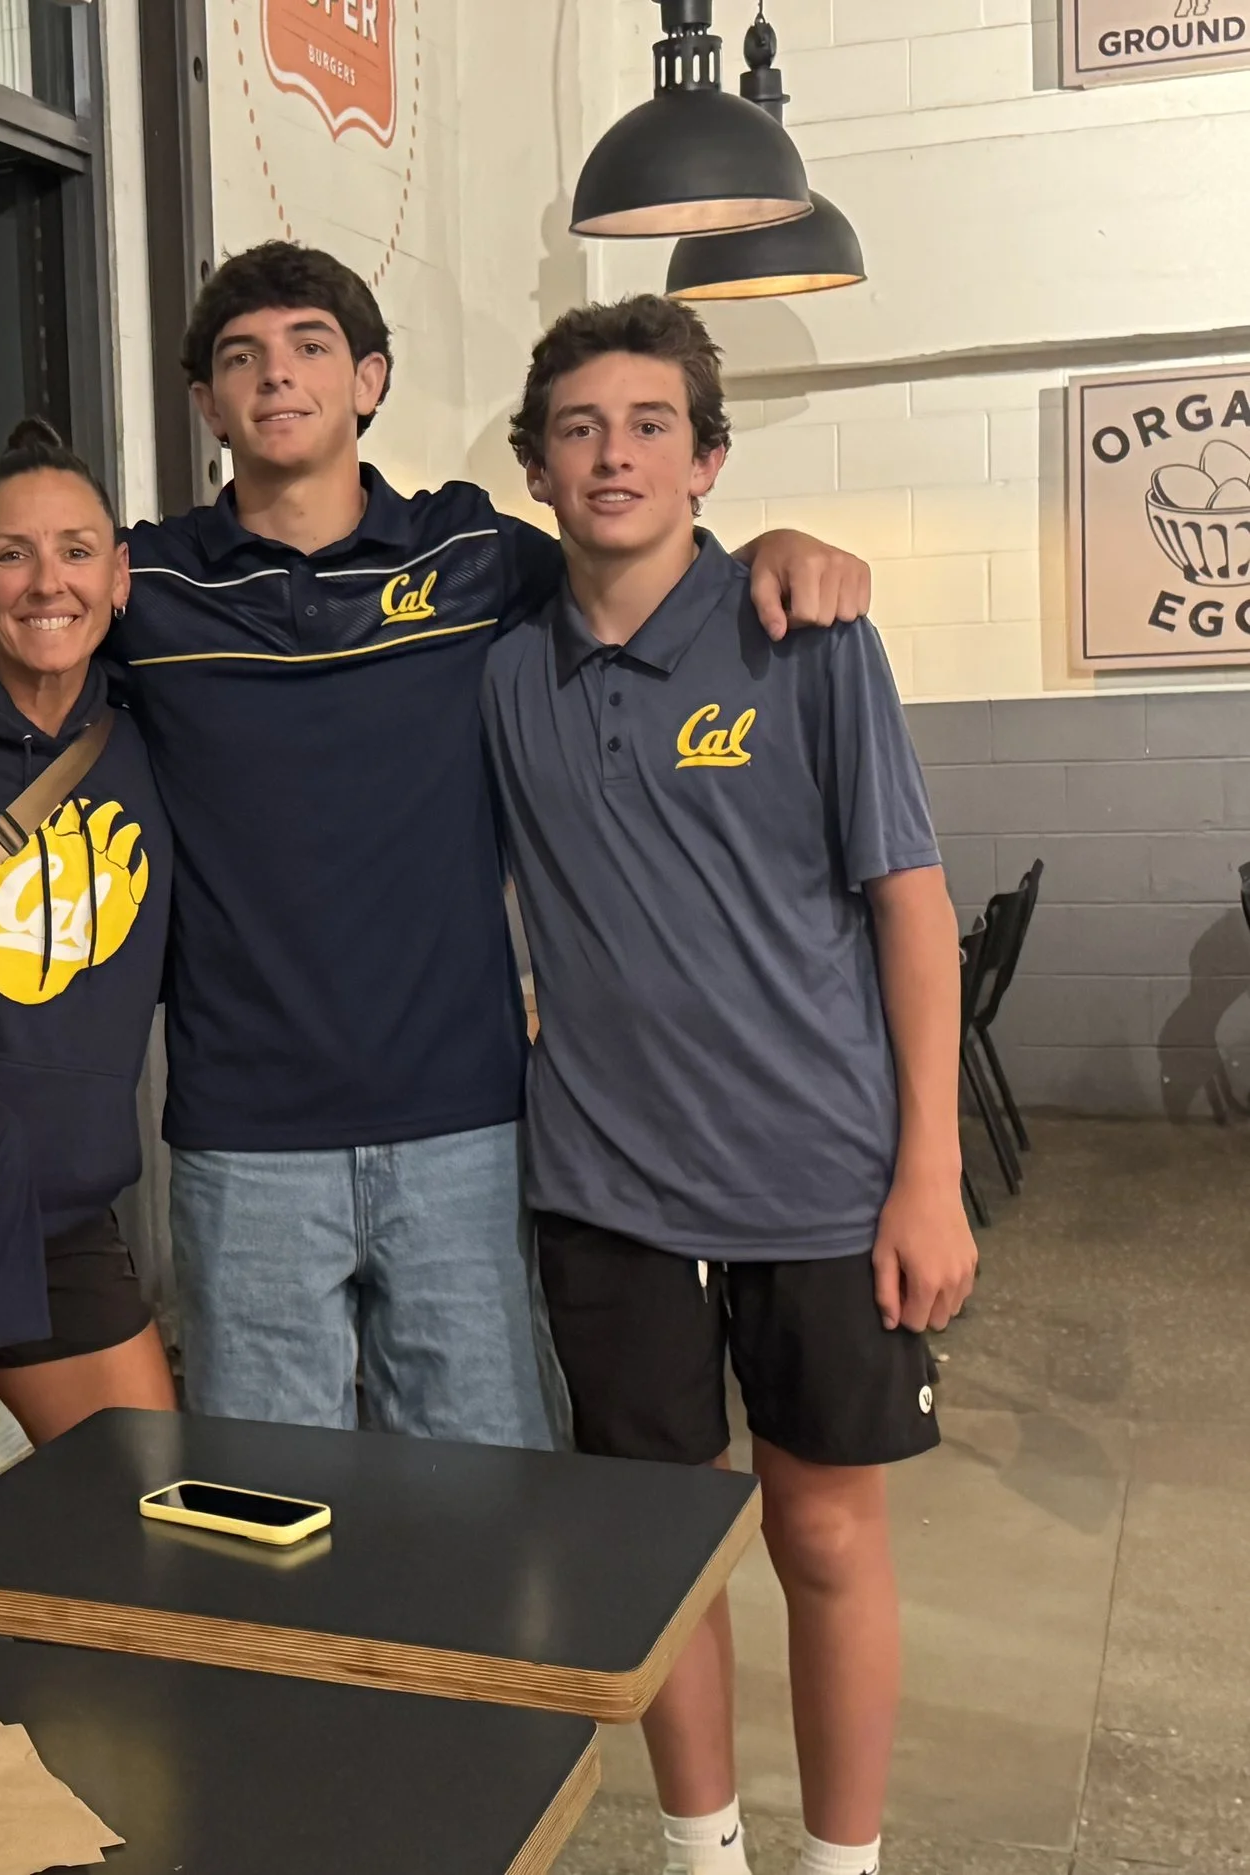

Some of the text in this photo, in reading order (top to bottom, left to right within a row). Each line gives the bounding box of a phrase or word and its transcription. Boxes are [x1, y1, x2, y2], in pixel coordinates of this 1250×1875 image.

[1098, 16, 1246, 57] GROUND
[308, 44, 357, 86] BURGERS
[380, 570, 438, 626] Cal
[675, 703, 757, 770] Cal
